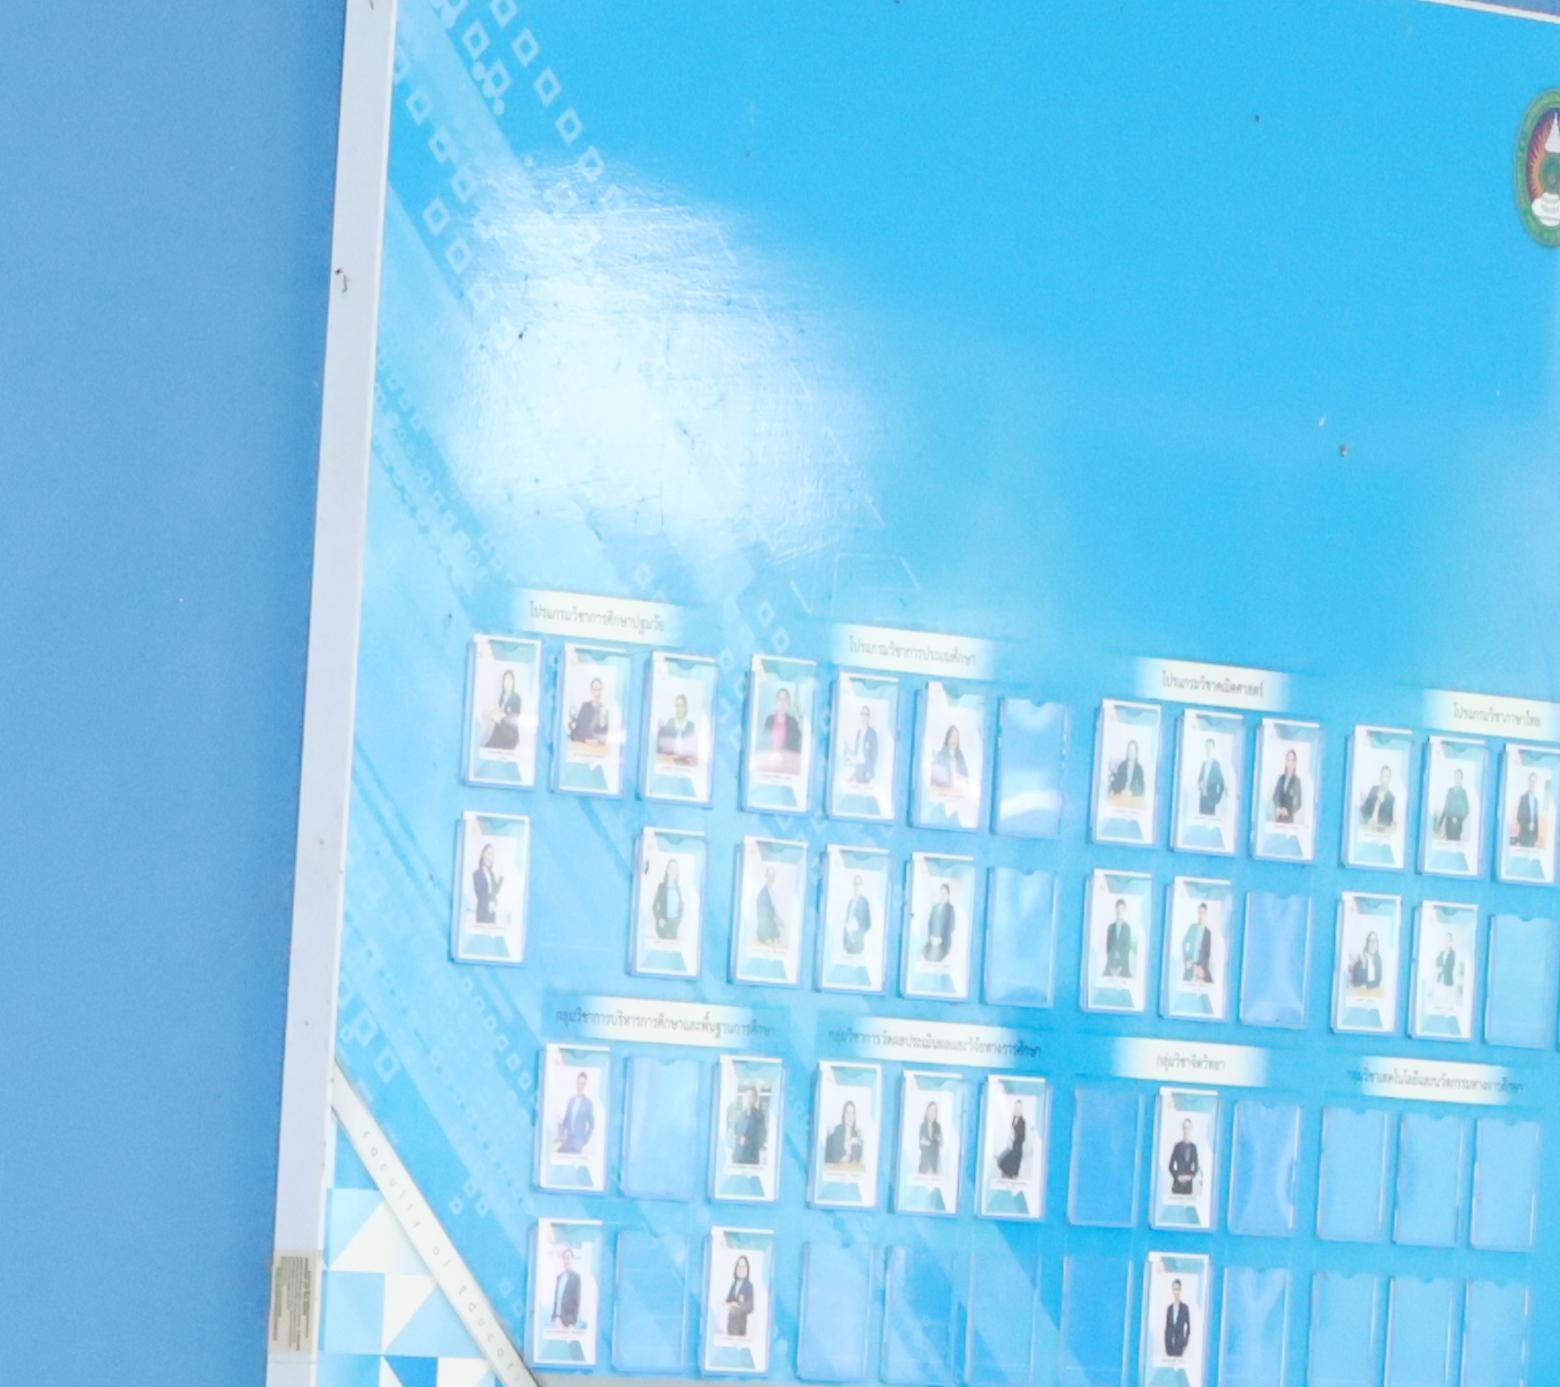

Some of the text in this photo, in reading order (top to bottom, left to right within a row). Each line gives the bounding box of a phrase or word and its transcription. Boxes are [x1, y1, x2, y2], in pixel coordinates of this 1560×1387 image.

[529, 600, 665, 636] โปรแกรมวิชาการศึกษาปฐมวัย
